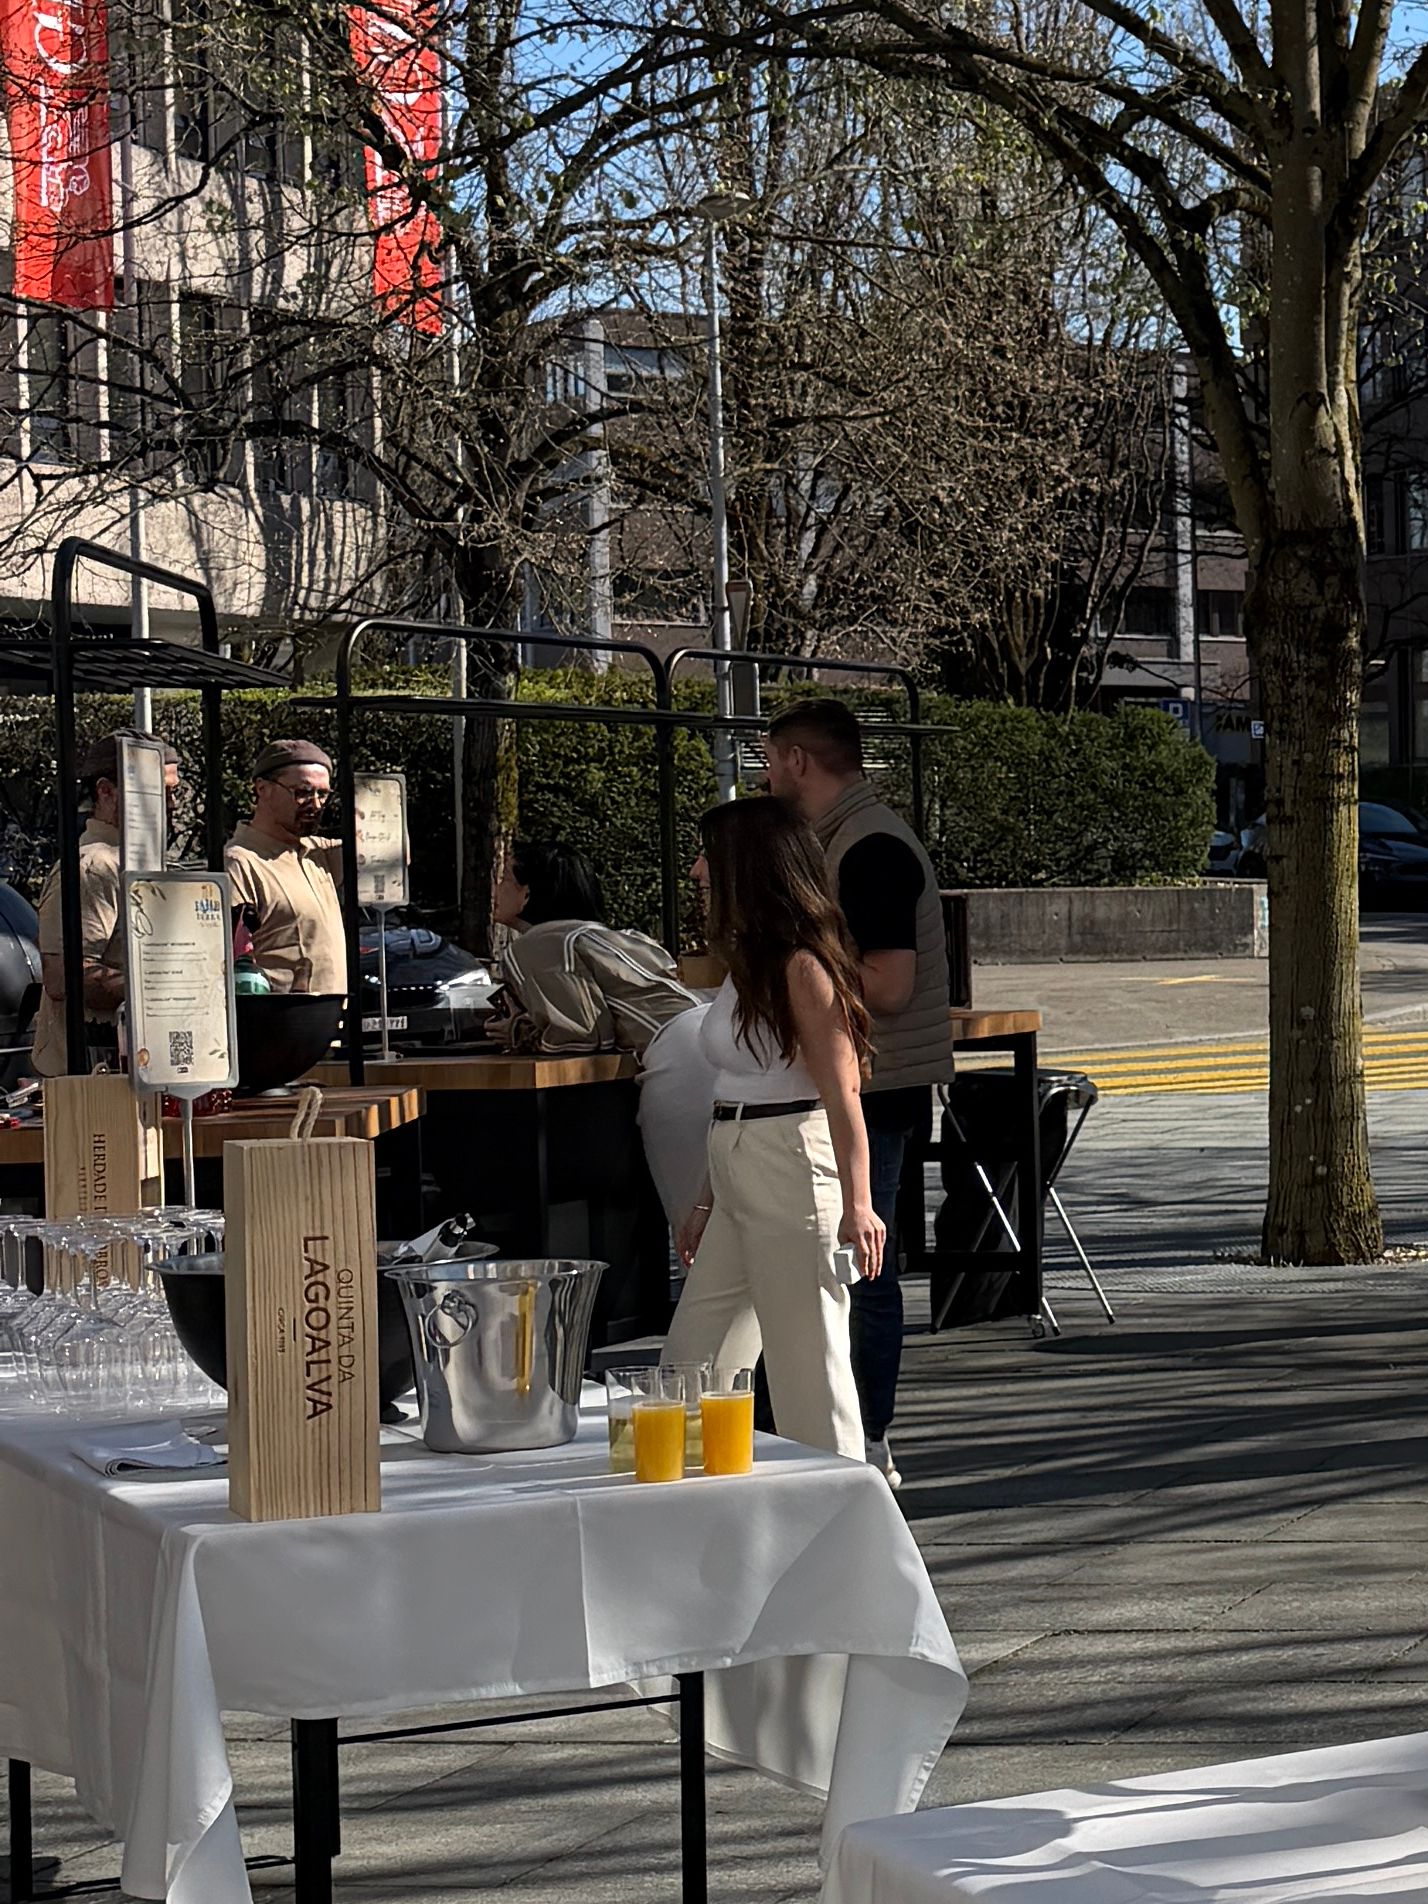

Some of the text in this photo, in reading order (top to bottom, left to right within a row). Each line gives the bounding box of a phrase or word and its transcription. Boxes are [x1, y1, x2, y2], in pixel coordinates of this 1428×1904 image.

[93, 1133, 107, 1200] HERDADE
[303, 1235, 333, 1420] LAGOALVA
[336, 1268, 355, 1383] QUINTA DA
